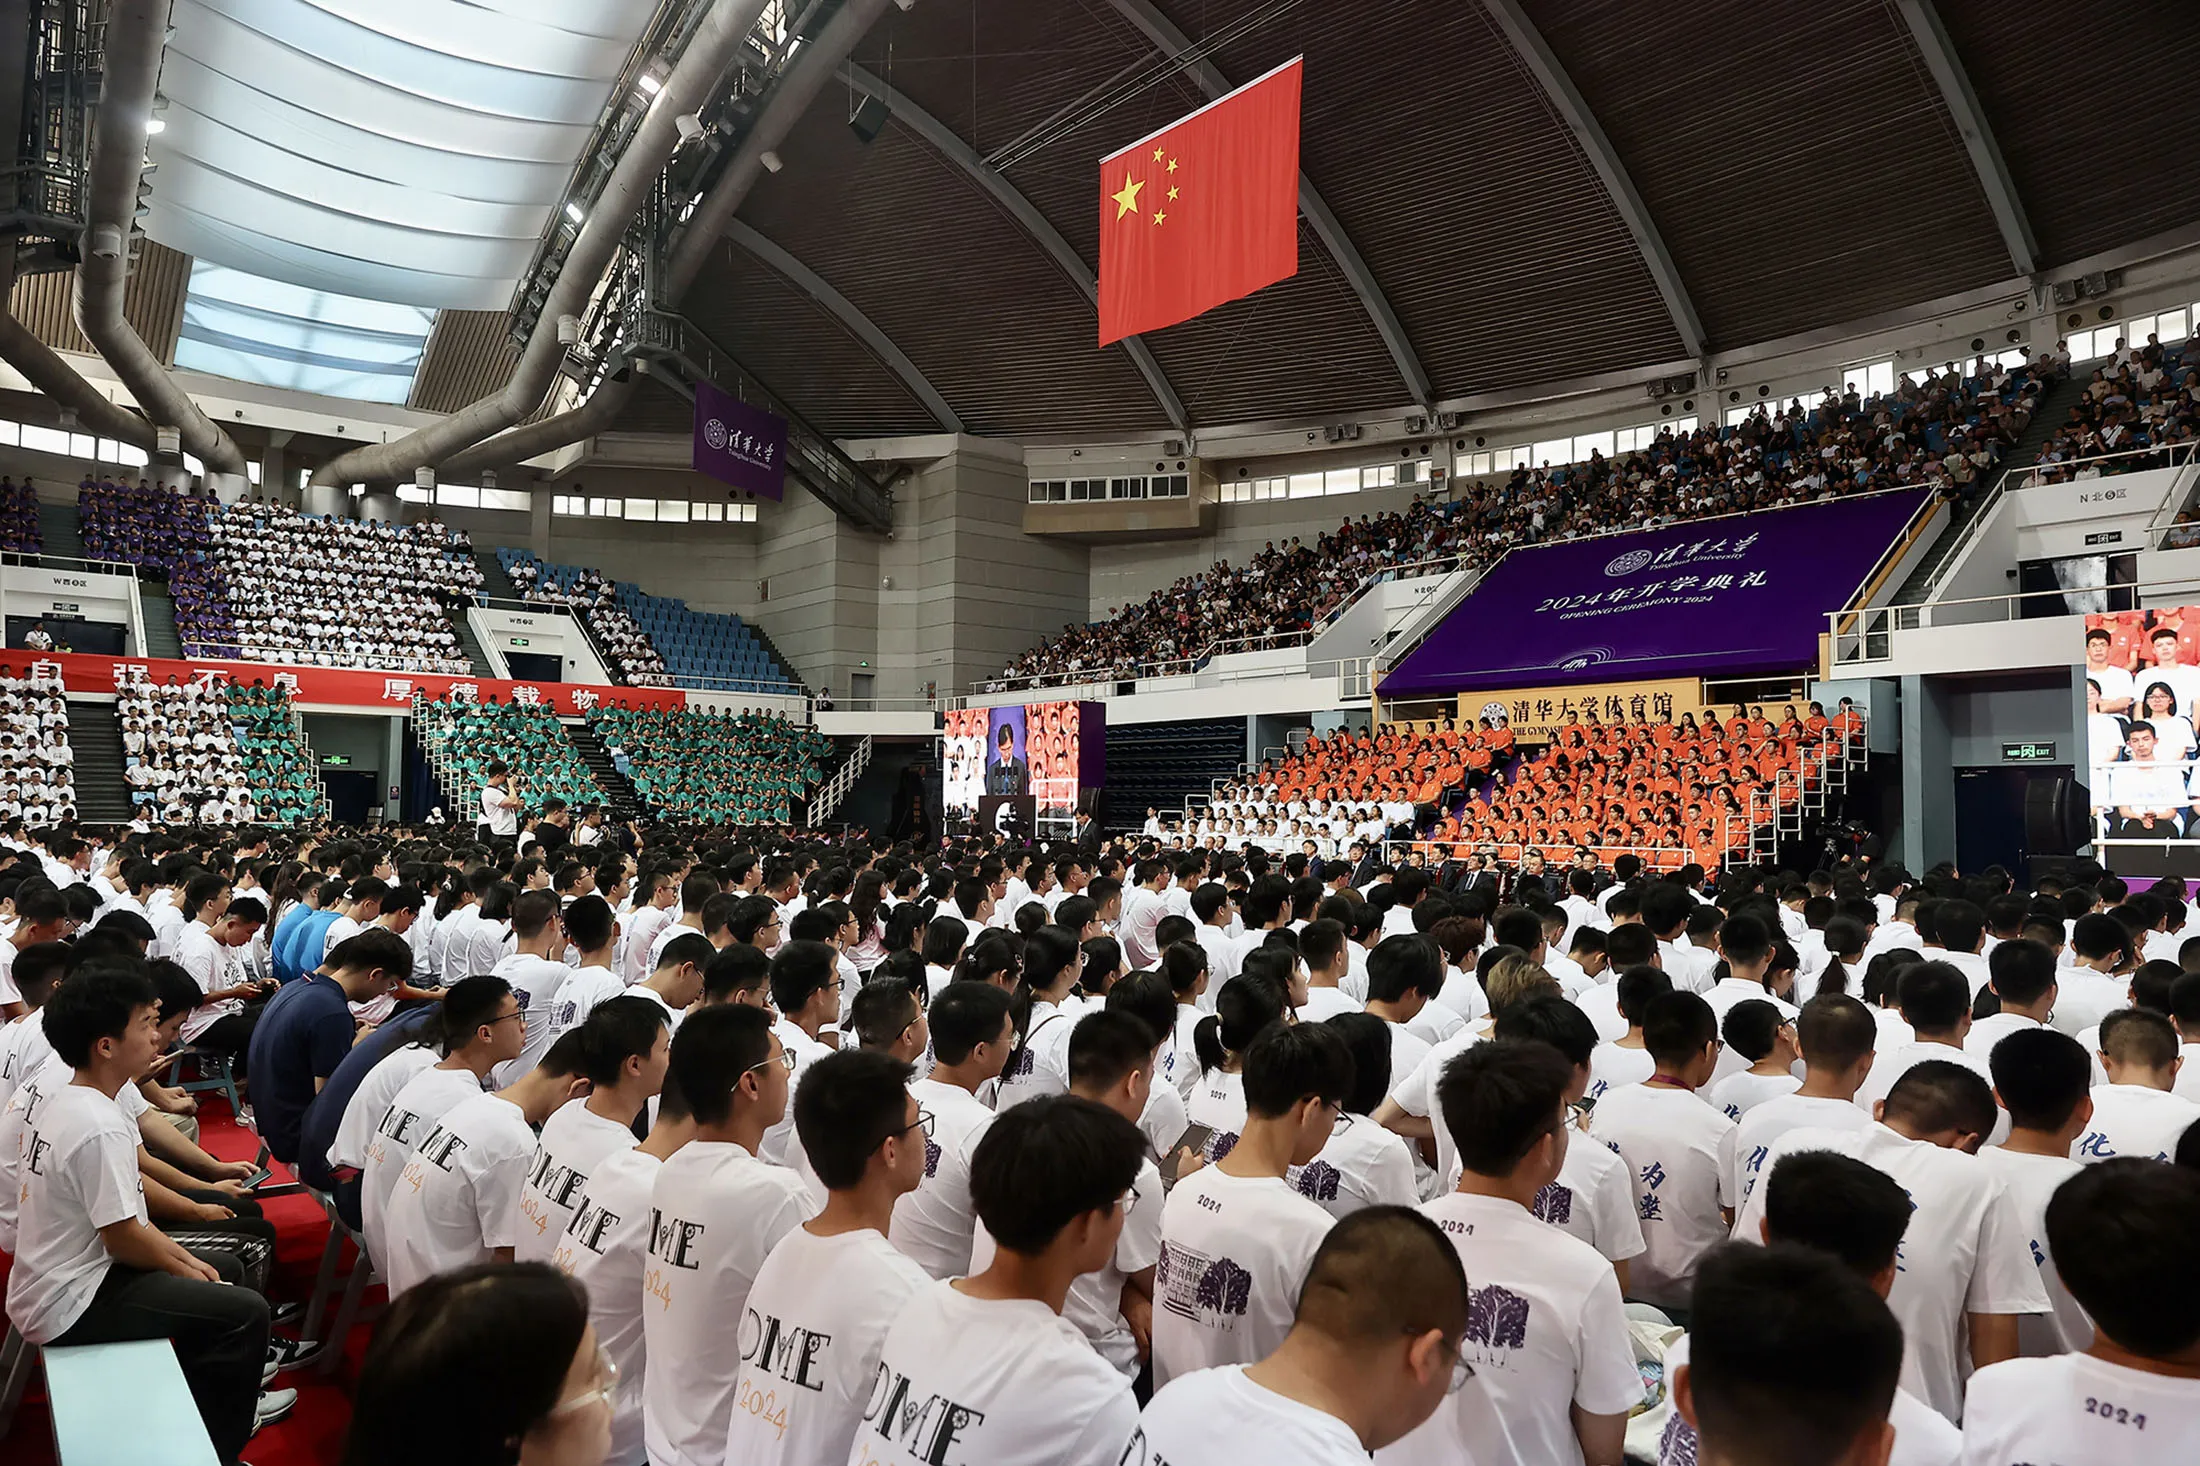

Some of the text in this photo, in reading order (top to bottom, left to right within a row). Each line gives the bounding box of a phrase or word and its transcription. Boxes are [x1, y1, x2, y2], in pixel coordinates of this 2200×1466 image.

[1649, 552, 1746, 571] Tsinghua University
[1559, 595, 1714, 620] OPENING CEREMONY 2024
[1513, 691, 1673, 723] 清华大学体育馆
[1512, 725, 1563, 736] THE GYMNASI
[2036, 748, 2050, 756] EXIT
[2079, 1131, 2116, 1157] 化
[1197, 1194, 1223, 1214] 2024
[1441, 1218, 1475, 1236] 2024
[738, 1378, 792, 1441] 2024
[2085, 1396, 2148, 1431] 2024
